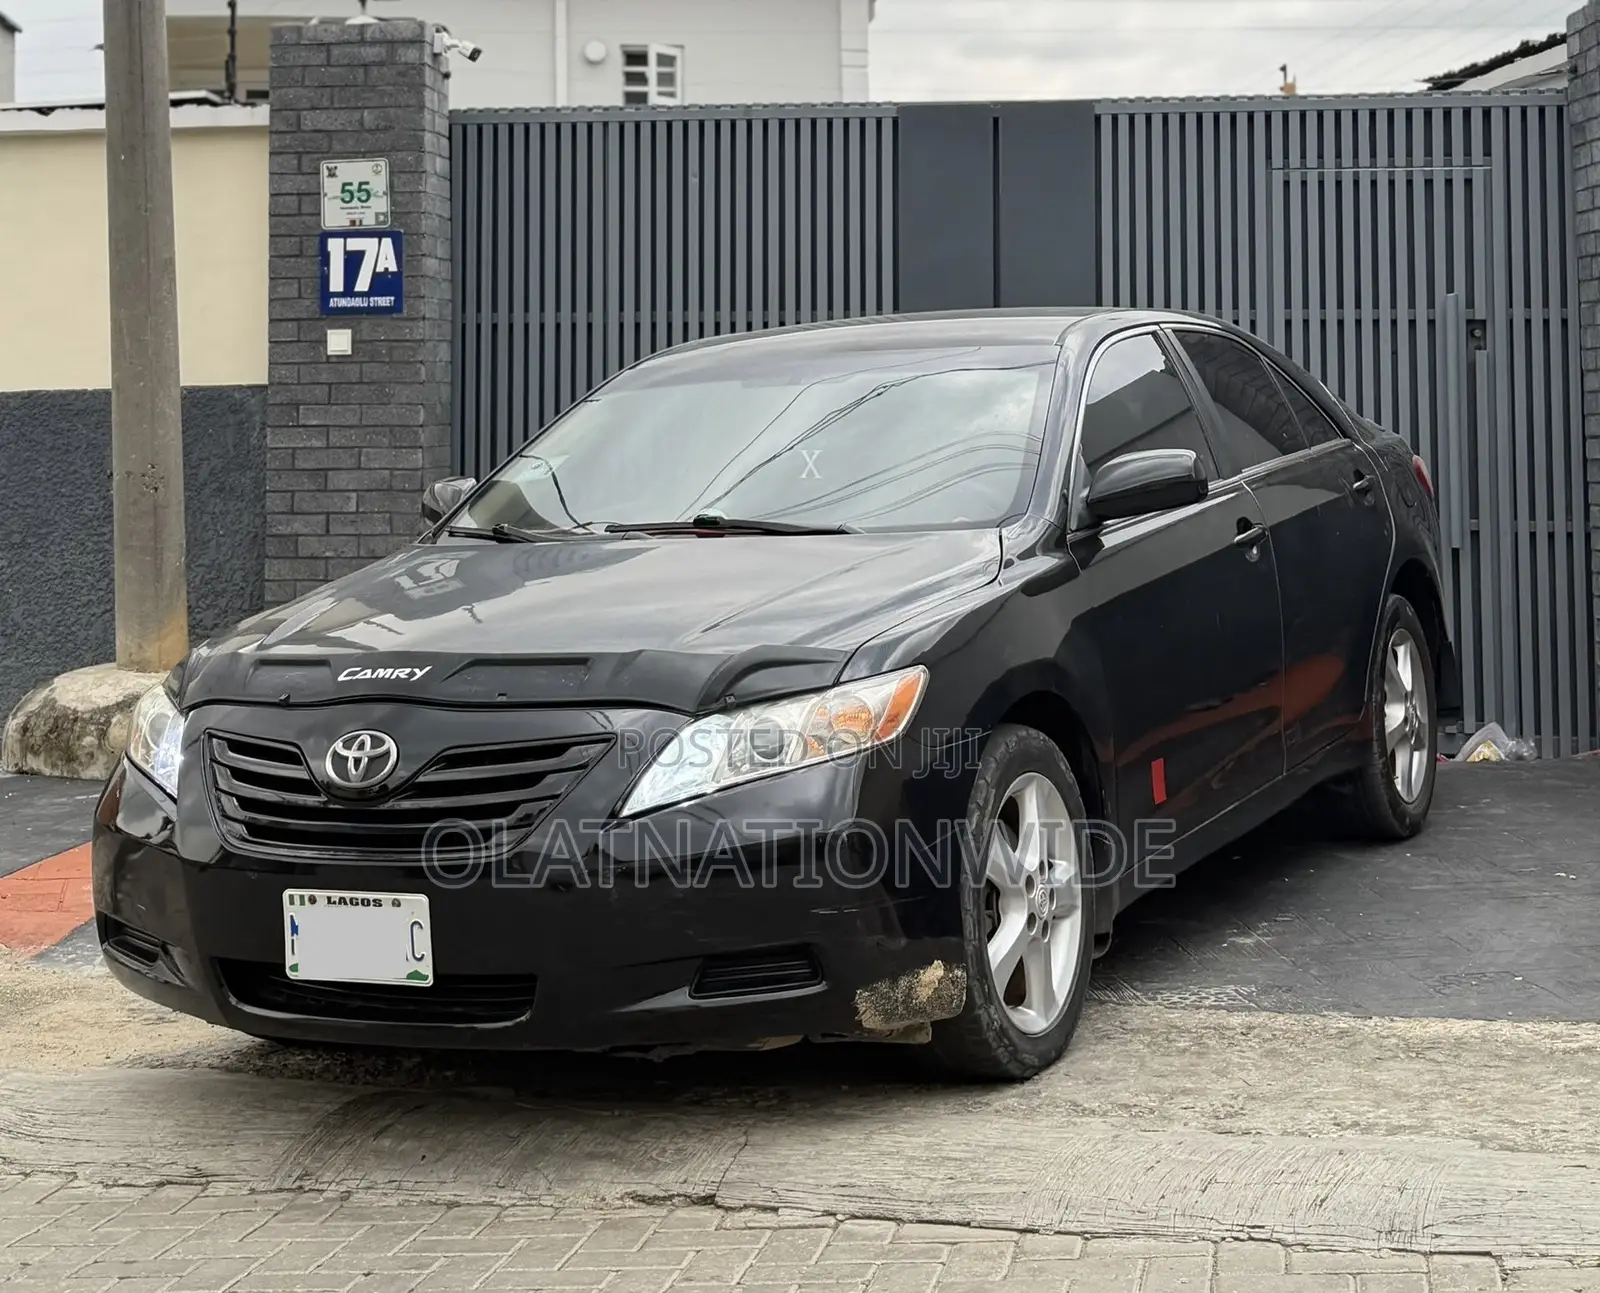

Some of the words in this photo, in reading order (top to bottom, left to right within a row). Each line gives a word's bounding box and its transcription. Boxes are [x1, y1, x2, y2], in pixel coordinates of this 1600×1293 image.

[340, 181, 372, 204] 55
[327, 237, 398, 292] 17A
[369, 296, 395, 307] STREET
[337, 665, 433, 681] CAMRY
[326, 896, 383, 908] LAGOS
